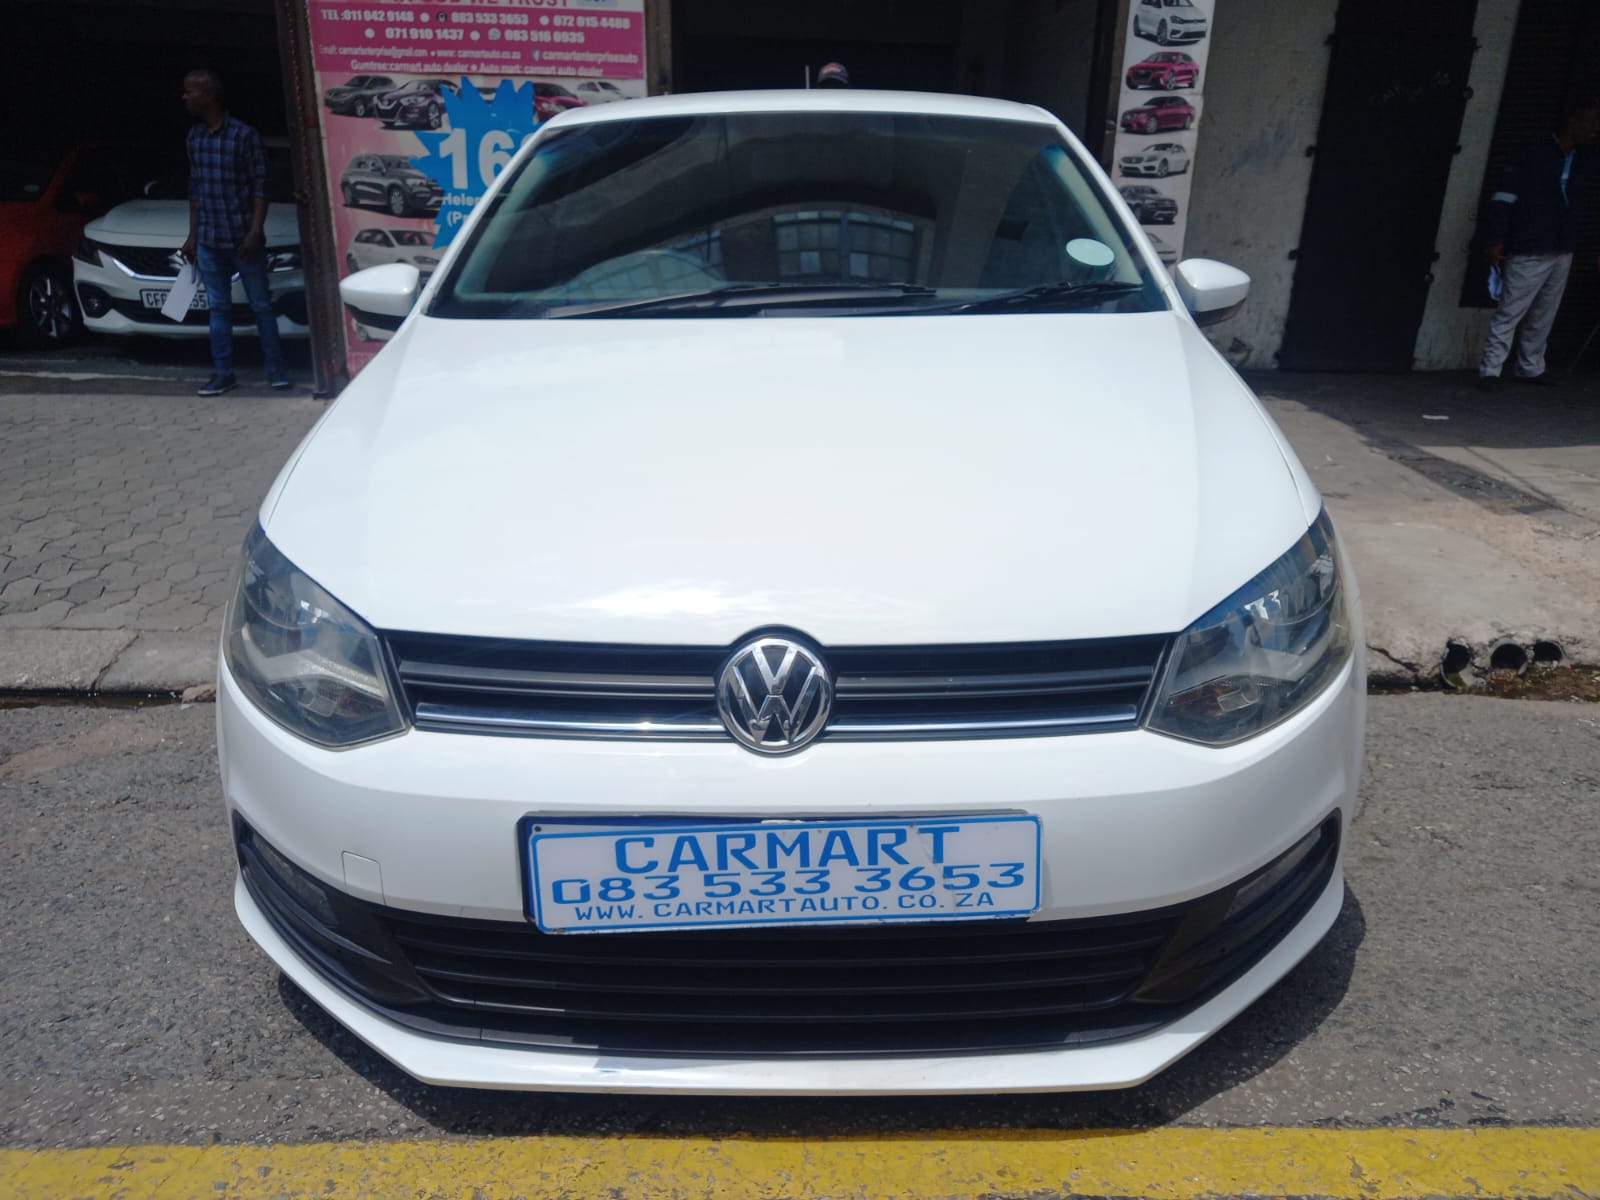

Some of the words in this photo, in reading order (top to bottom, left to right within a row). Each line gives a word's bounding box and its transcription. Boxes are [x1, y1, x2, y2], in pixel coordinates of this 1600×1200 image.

[439, 128, 535, 190] 16
[615, 826, 960, 874] CARMART
[552, 874, 680, 905] 083
[703, 869, 831, 899] 533
[855, 862, 1026, 893] 3653
